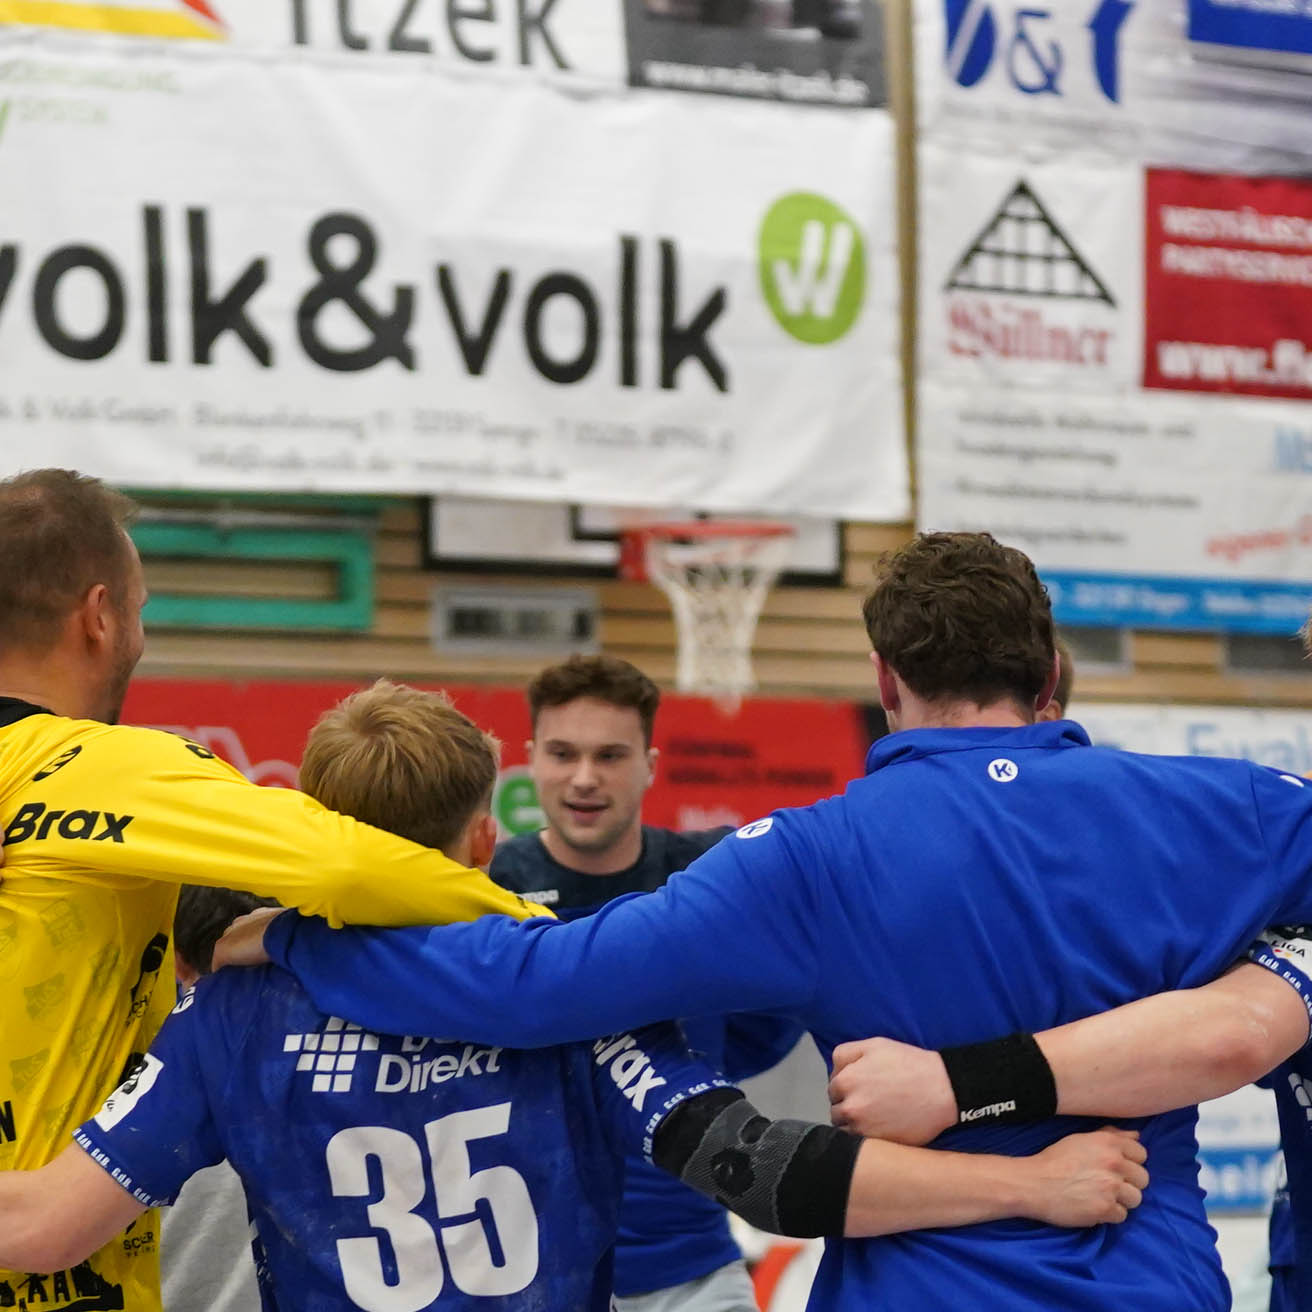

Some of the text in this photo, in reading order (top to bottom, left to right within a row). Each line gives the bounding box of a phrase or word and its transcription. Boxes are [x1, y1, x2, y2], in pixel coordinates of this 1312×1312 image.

[4, 802, 135, 845] Brax
[375, 1043, 503, 1095] Direkt
[592, 1034, 668, 1113] rax
[960, 1099, 1017, 1123] Kempa
